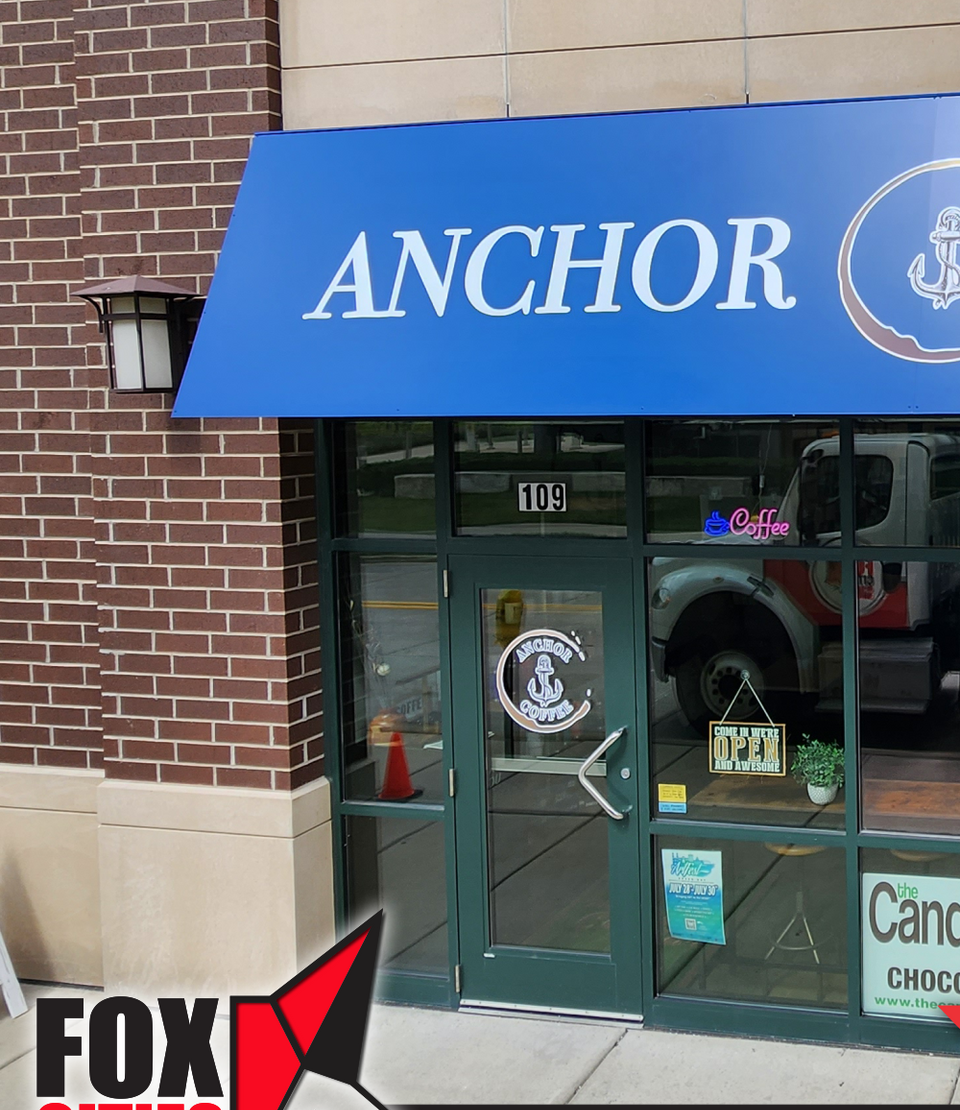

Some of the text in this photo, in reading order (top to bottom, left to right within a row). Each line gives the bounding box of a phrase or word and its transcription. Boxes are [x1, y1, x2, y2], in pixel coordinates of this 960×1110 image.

[302, 216, 797, 320] ANCHOR
[522, 483, 565, 511] 109
[729, 507, 790, 540] Coffee
[516, 638, 573, 664] ANCHOR
[520, 699, 575, 722] COFFEE
[714, 726, 738, 737] COME
[740, 727, 749, 737] IN
[714, 736, 780, 763] OPEN
[714, 761, 780, 773] AND AWESOME
[897, 882, 918, 899] the
